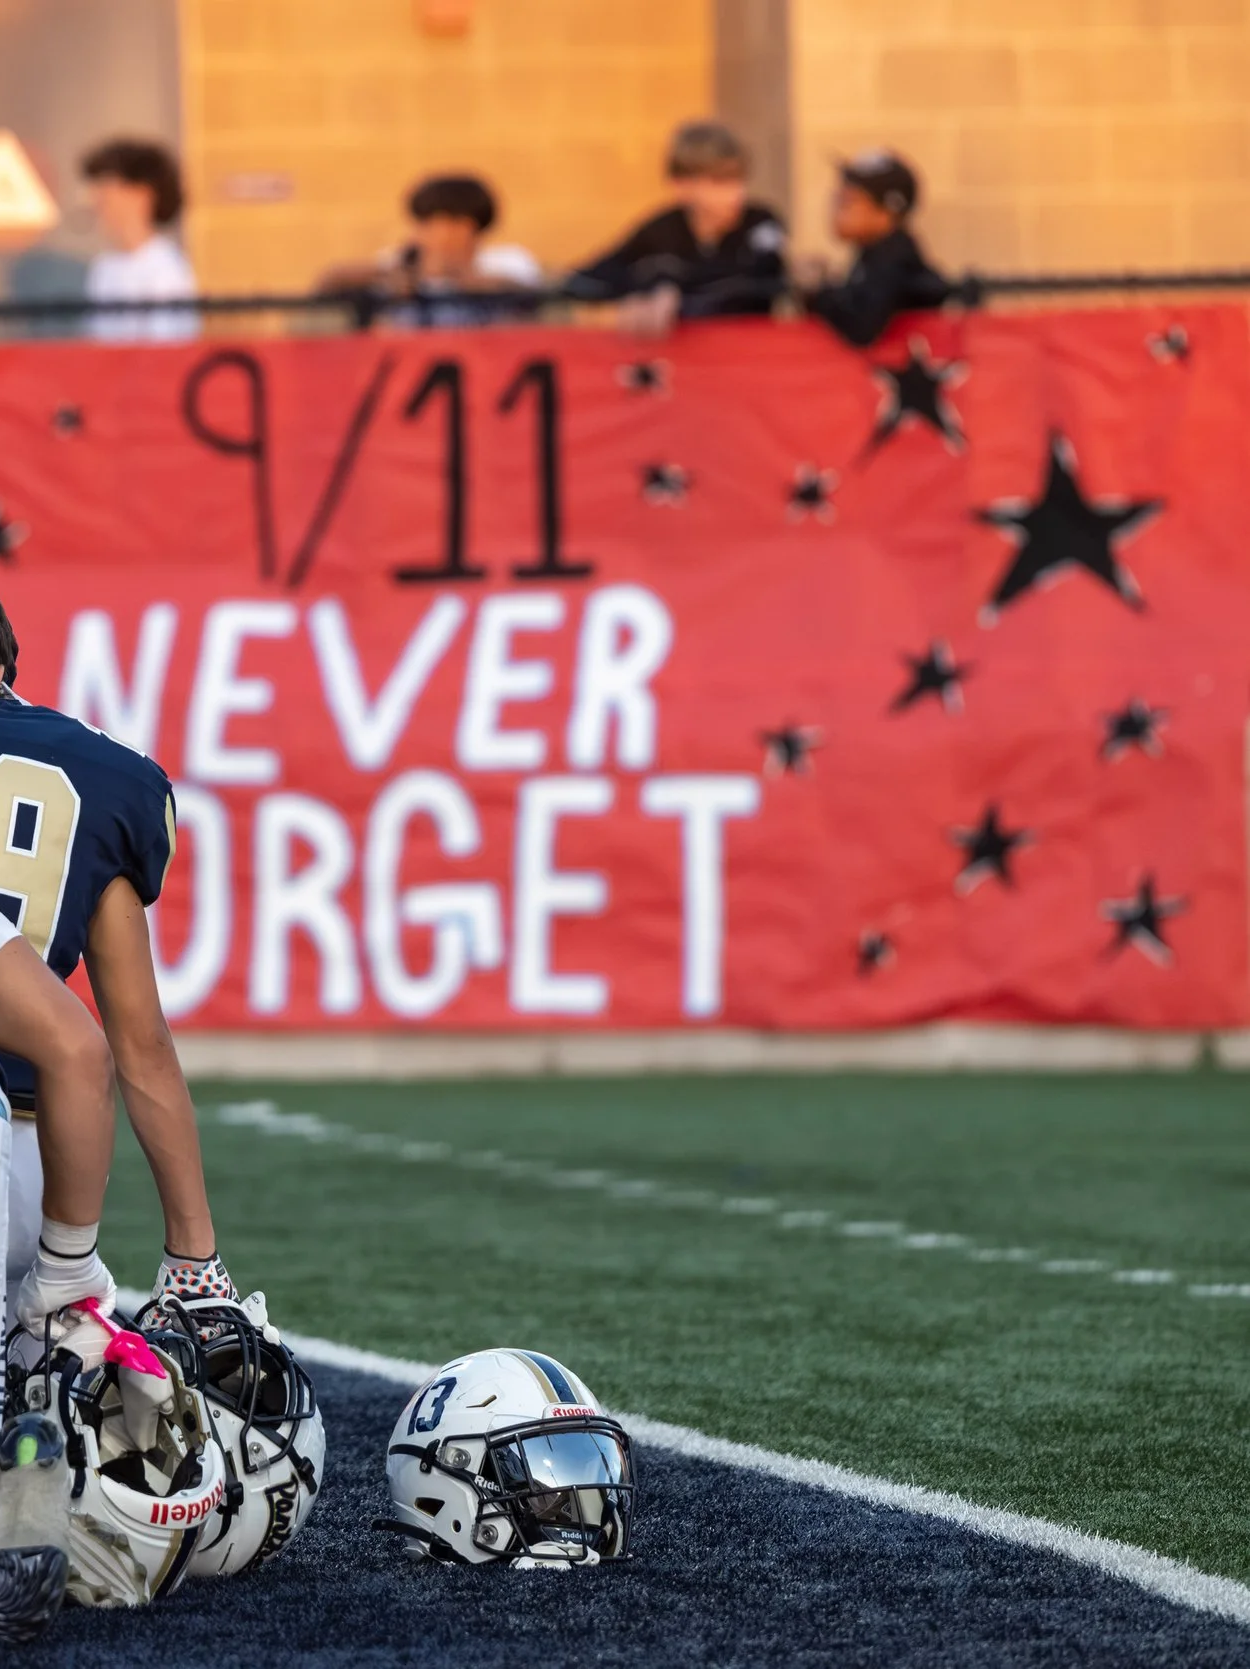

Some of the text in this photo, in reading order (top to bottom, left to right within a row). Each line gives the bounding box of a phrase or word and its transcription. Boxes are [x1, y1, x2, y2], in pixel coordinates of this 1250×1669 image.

[182, 349, 598, 589] 9/11
[58, 583, 674, 786] NEVER
[145, 768, 761, 1019] ORGET
[150, 1478, 224, 1526] Riddell
[407, 1376, 458, 1437] 13
